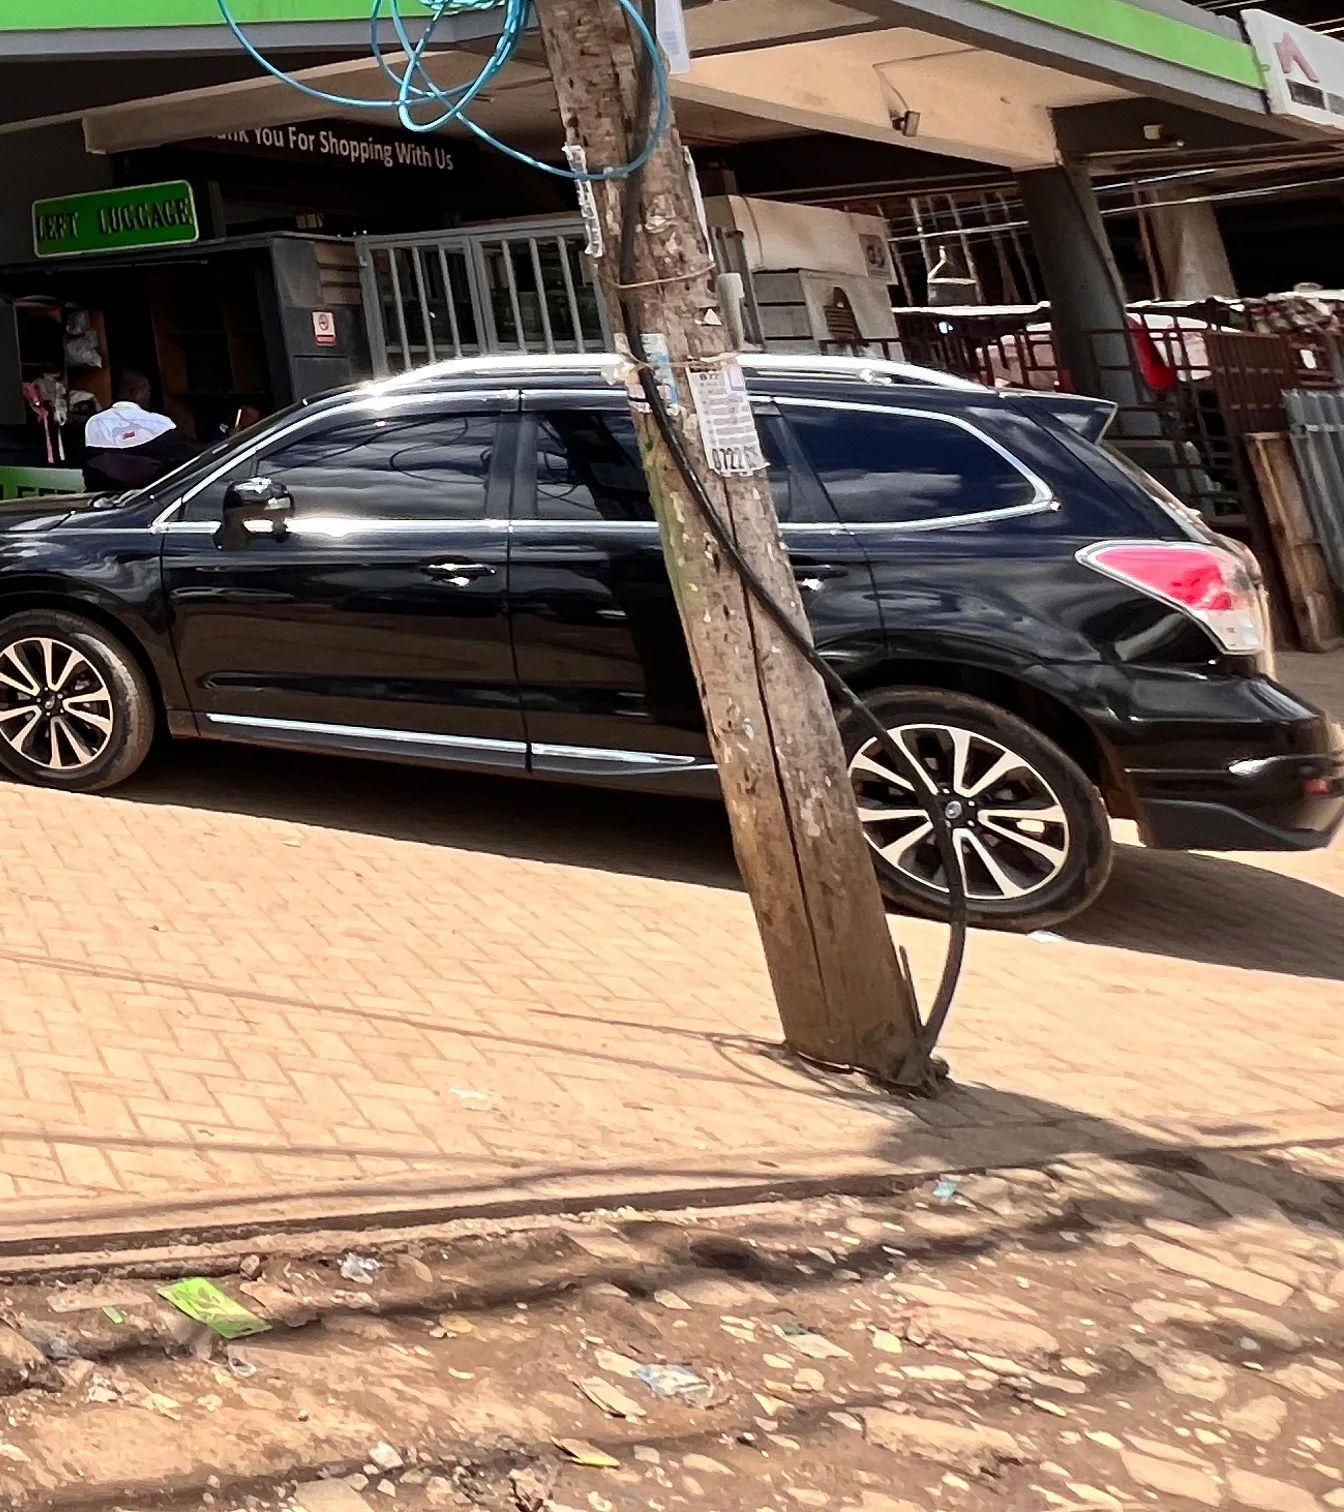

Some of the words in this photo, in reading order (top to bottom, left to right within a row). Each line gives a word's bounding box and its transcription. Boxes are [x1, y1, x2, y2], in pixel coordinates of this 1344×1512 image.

[254, 127, 284, 147] You
[288, 126, 314, 151] For
[320, 131, 394, 167] Shopping
[395, 141, 432, 168] With
[434, 147, 454, 170] Us
